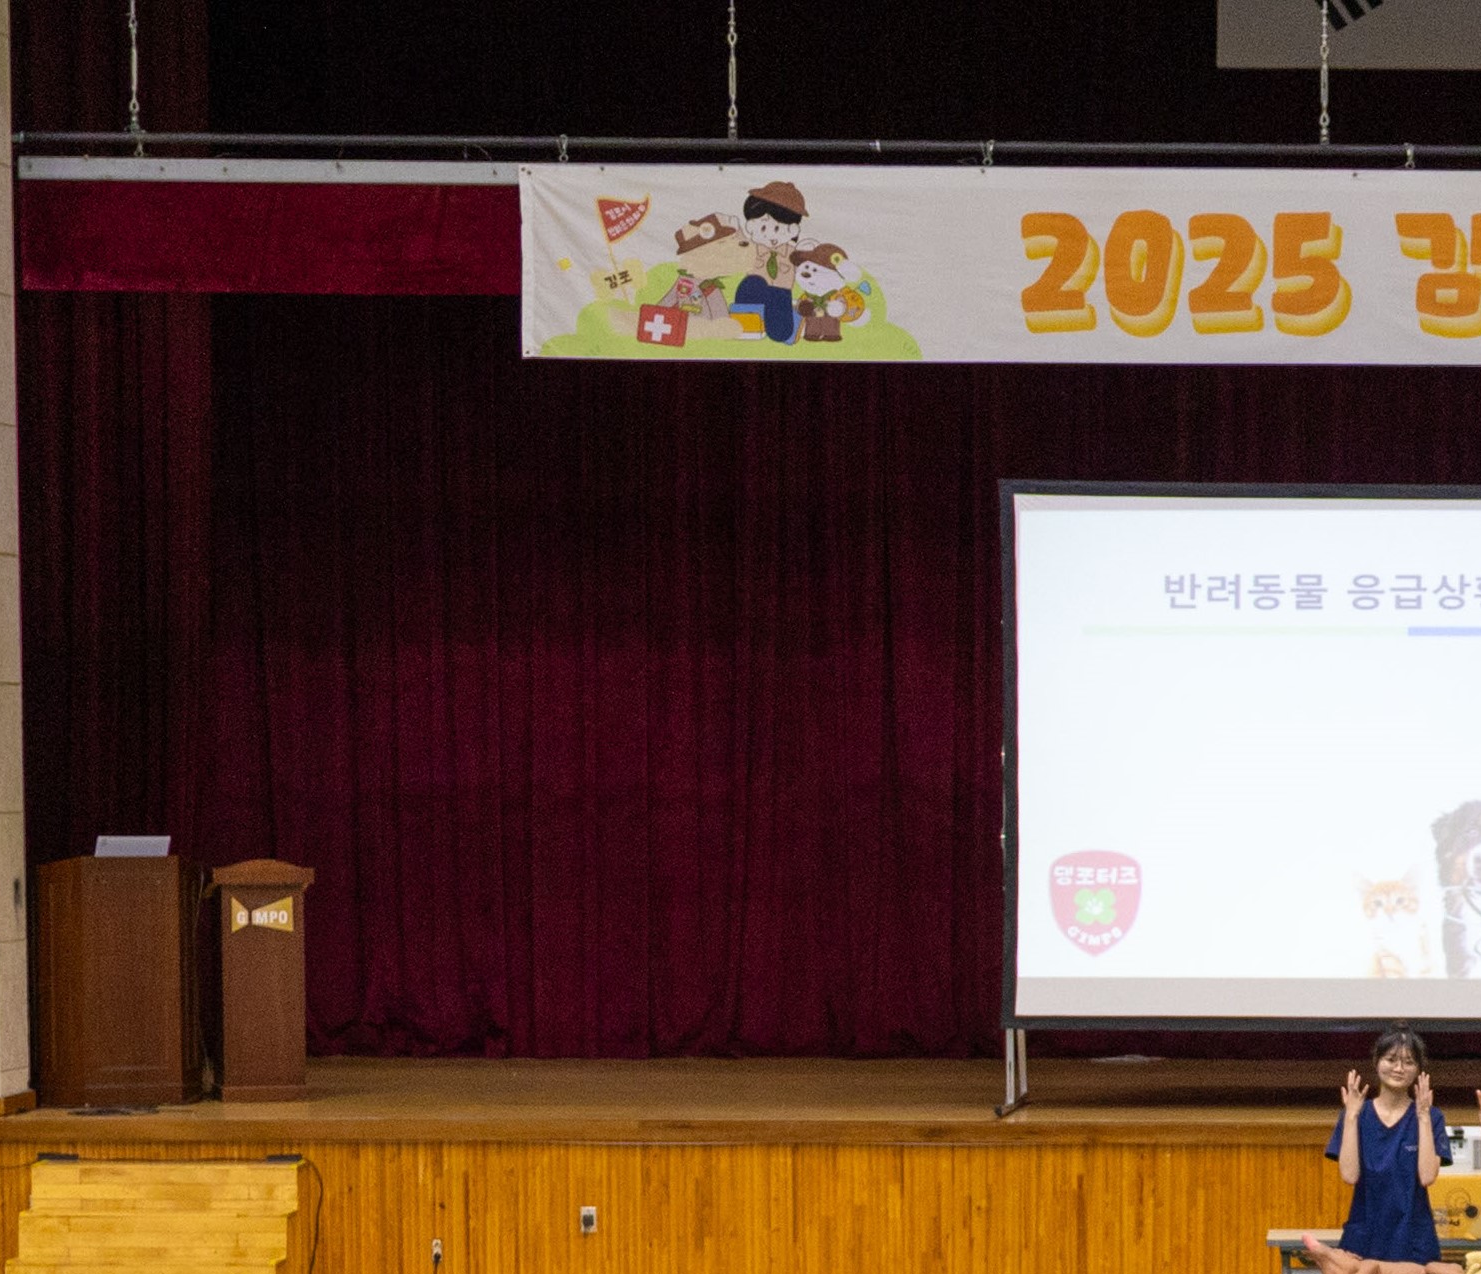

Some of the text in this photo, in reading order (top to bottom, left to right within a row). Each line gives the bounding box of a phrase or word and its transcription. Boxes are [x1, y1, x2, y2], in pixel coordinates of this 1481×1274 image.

[604, 270, 633, 289] 김포
[1021, 209, 1351, 336] 2025
[1162, 572, 1329, 611] 반려동물
[1054, 865, 1139, 885] 댕포터즈
